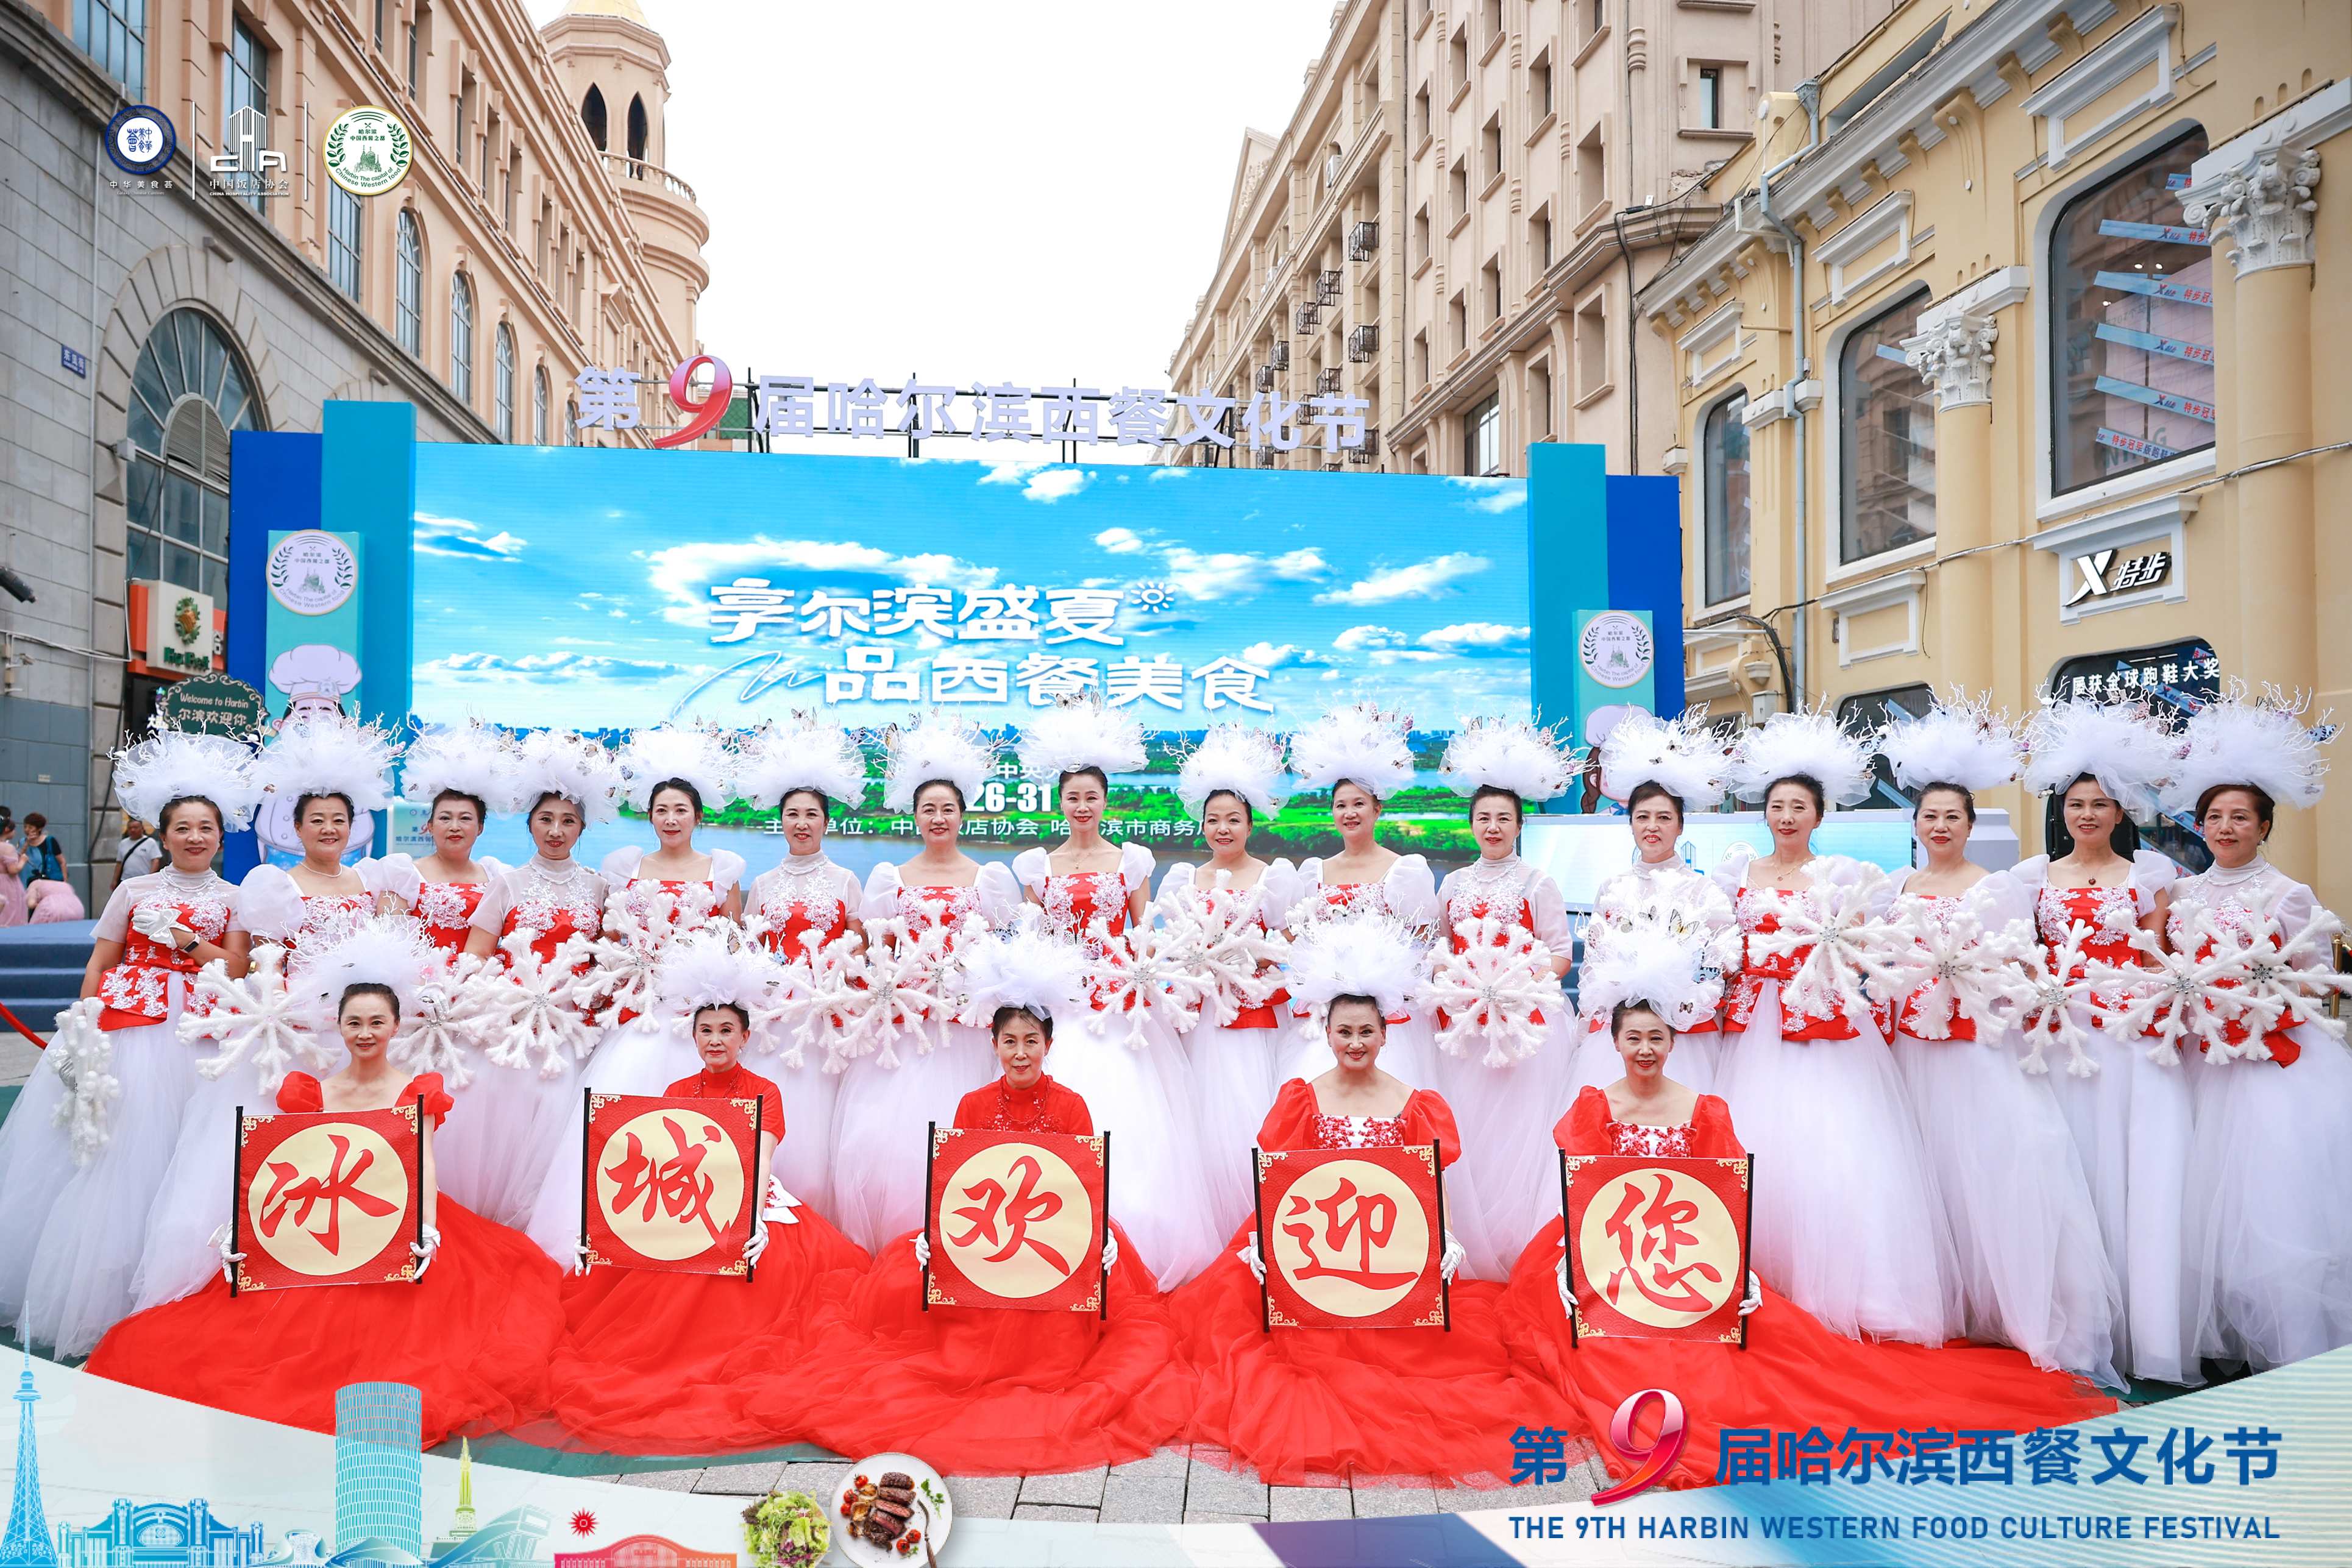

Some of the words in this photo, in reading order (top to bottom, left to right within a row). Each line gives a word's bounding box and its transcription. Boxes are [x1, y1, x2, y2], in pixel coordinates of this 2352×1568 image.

[709, 577, 1126, 645] 享尔滨盛夏
[180, 692, 213, 705] Welcome
[215, 697, 222, 706] to
[224, 697, 249, 709] Harbin
[825, 645, 1275, 712] 品西餐美食
[179, 708, 247, 726] 尔滨欢迎你
[259, 1134, 400, 1256] 冰
[605, 1116, 731, 1252] 城
[945, 1155, 1070, 1277] 欢
[1282, 1176, 1419, 1281] 迎
[1606, 1172, 1723, 1313] 您
